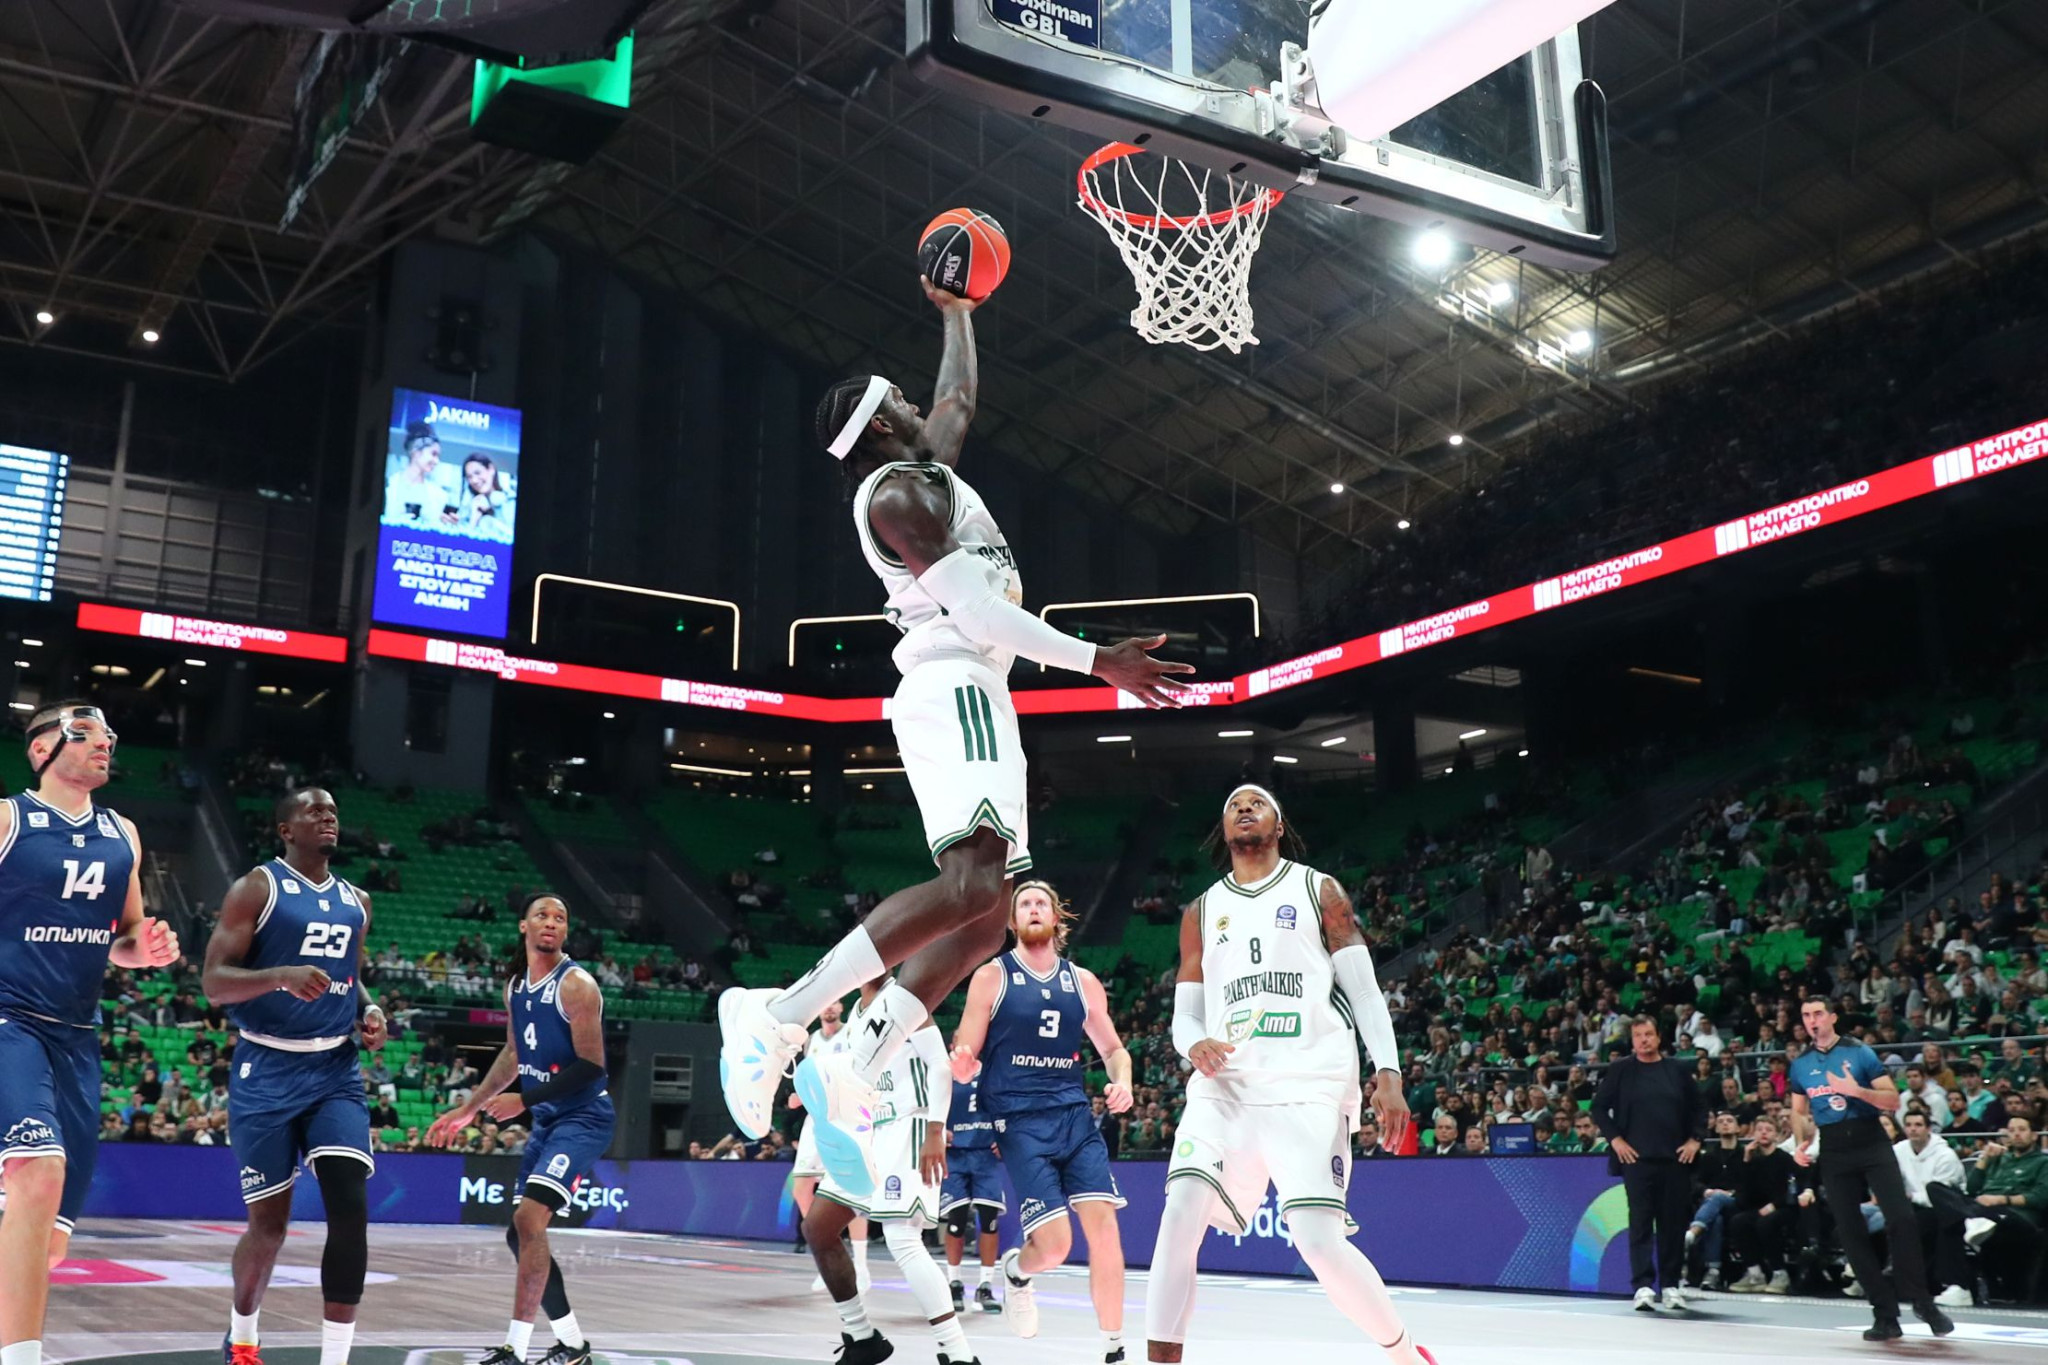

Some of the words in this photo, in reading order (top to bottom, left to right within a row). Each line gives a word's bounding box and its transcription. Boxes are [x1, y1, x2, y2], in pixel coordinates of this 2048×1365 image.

[1020, 9, 1068, 41] GBL
[438, 405, 490, 429] ΑΚΜΗ
[1749, 480, 1869, 530] ΜΗΤΡΟΠΟΛΙΤΙΚΟ
[1750, 511, 1821, 544] ΚΟΛΛΕΓΙΟ
[1561, 546, 1663, 588] ΜΗΤΡΟΠΟΛΙΤΙΚΟ
[1563, 573, 1622, 602] ΚΟΛΛΕΓΙΟ
[175, 617, 288, 643] ΜΗΤΡΟΠΟΛΙΤΙΚΟ
[1404, 601, 1490, 637] ΜΗΤΡΟΠΟΛΙΤΙΚΟ
[61, 859, 106, 900] 14
[299, 922, 352, 958] 23
[1250, 937, 1262, 964] 8
[523, 1022, 537, 1050] 4
[1038, 1009, 1060, 1038] 3
[459, 1177, 504, 1204] Με
[572, 1179, 629, 1212] ξεις.
